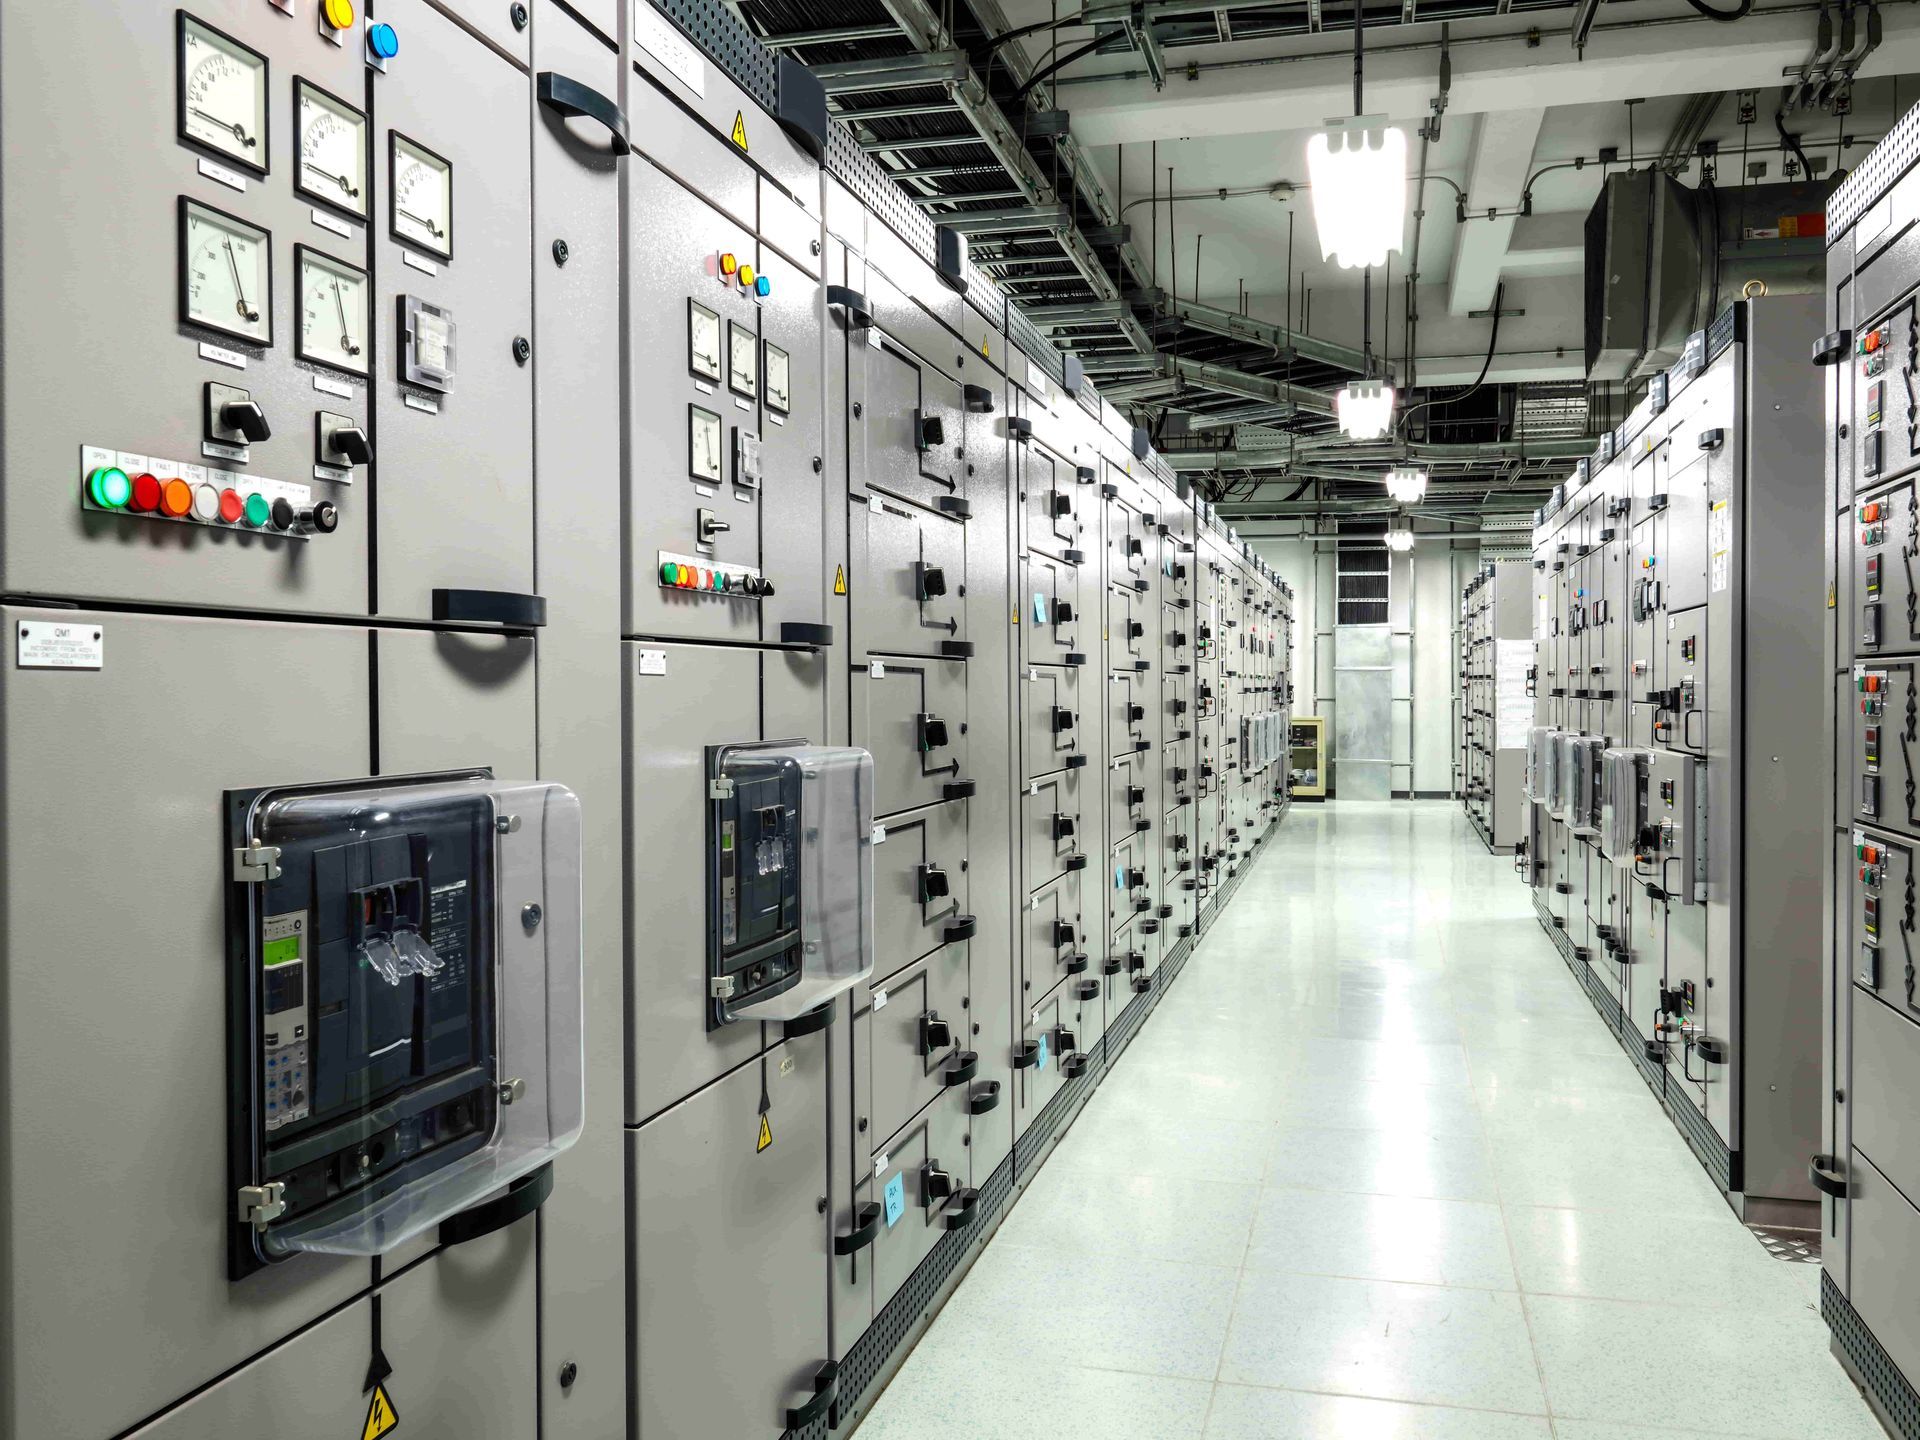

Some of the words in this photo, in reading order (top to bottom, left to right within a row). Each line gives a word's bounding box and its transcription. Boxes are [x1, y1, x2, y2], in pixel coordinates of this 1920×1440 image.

[191, 217, 198, 230] V
[93, 451, 107, 460] OPEN
[124, 457, 141, 466] CLOSE
[155, 462, 171, 471] FAULT
